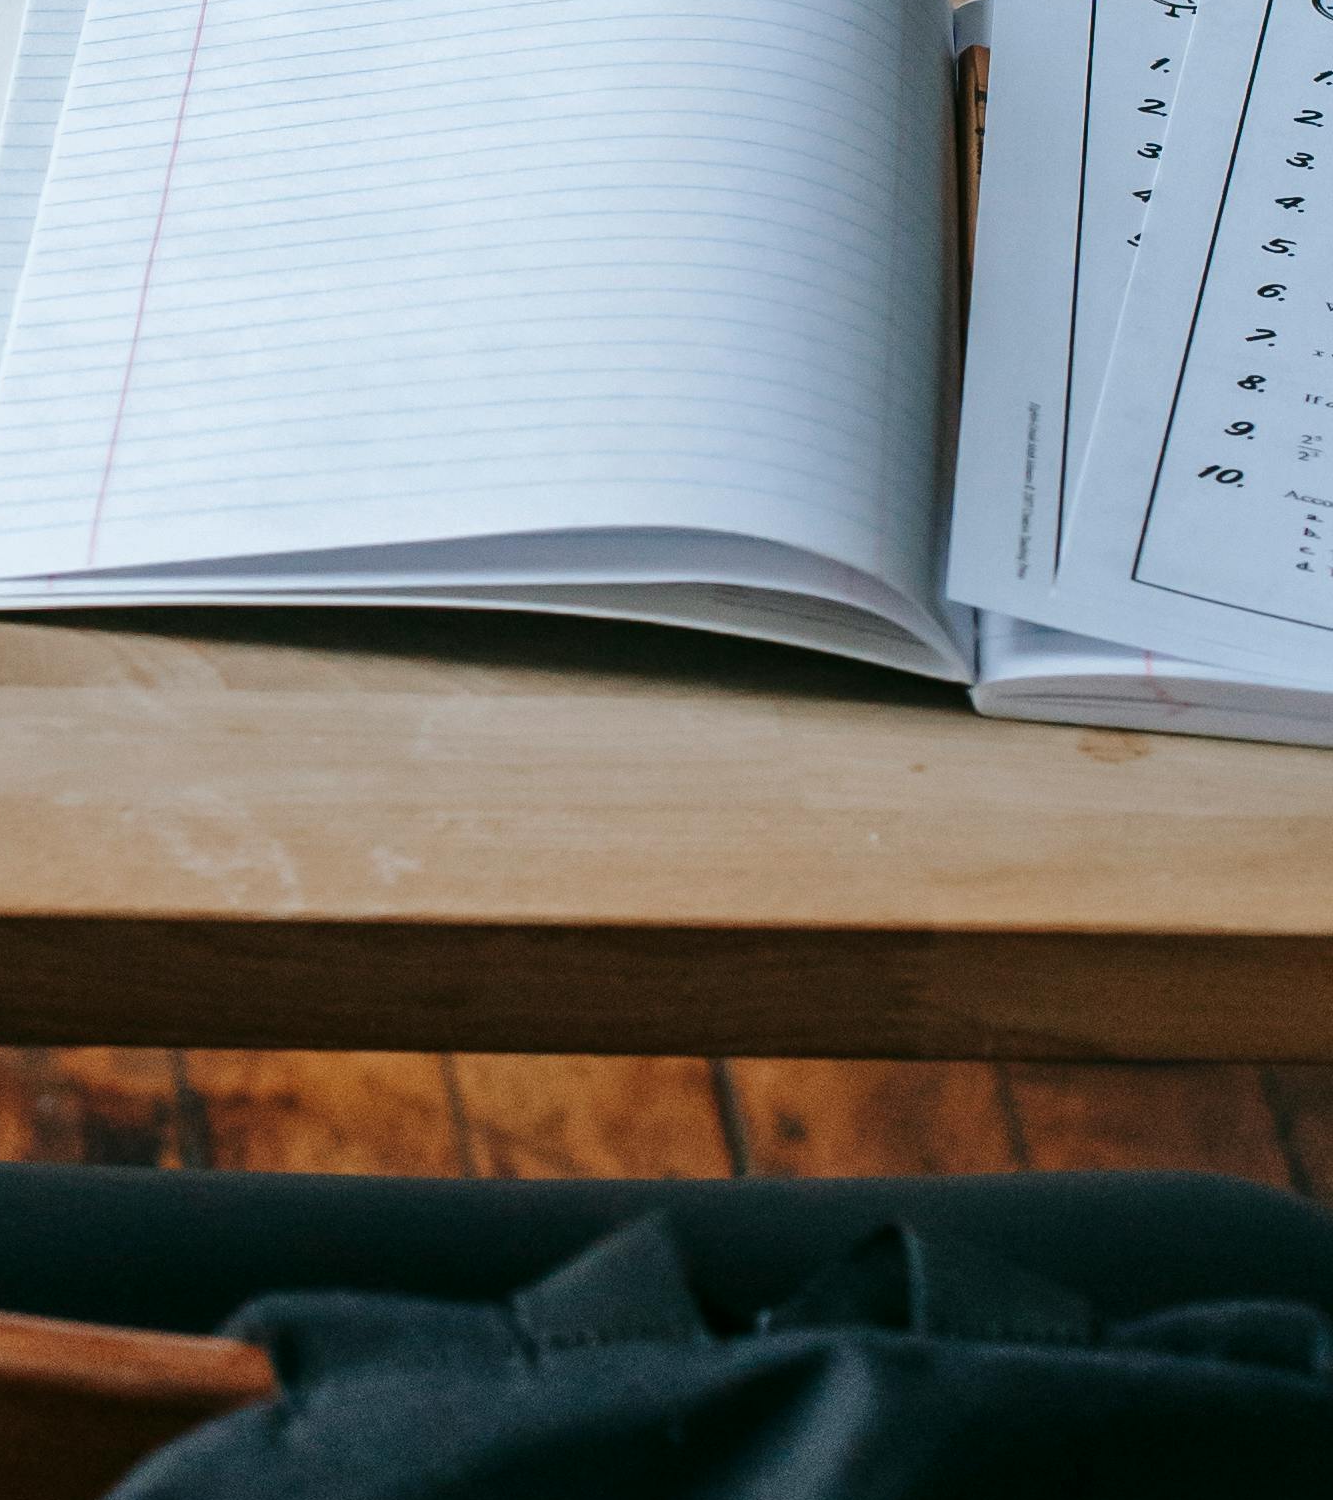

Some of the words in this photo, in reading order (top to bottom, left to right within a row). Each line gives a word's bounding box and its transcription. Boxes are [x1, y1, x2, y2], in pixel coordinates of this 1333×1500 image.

[1150, 58, 1170, 73] 1.
[1286, 152, 1314, 170] 3.
[1275, 197, 1305, 212] 4.
[1261, 238, 1296, 256] 5.
[1257, 284, 1287, 301] 6.
[1245, 328, 1277, 346] 7.
[1237, 375, 1266, 392] 8.
[1224, 421, 1254, 440] 9.
[1198, 465, 1243, 487] 10.
